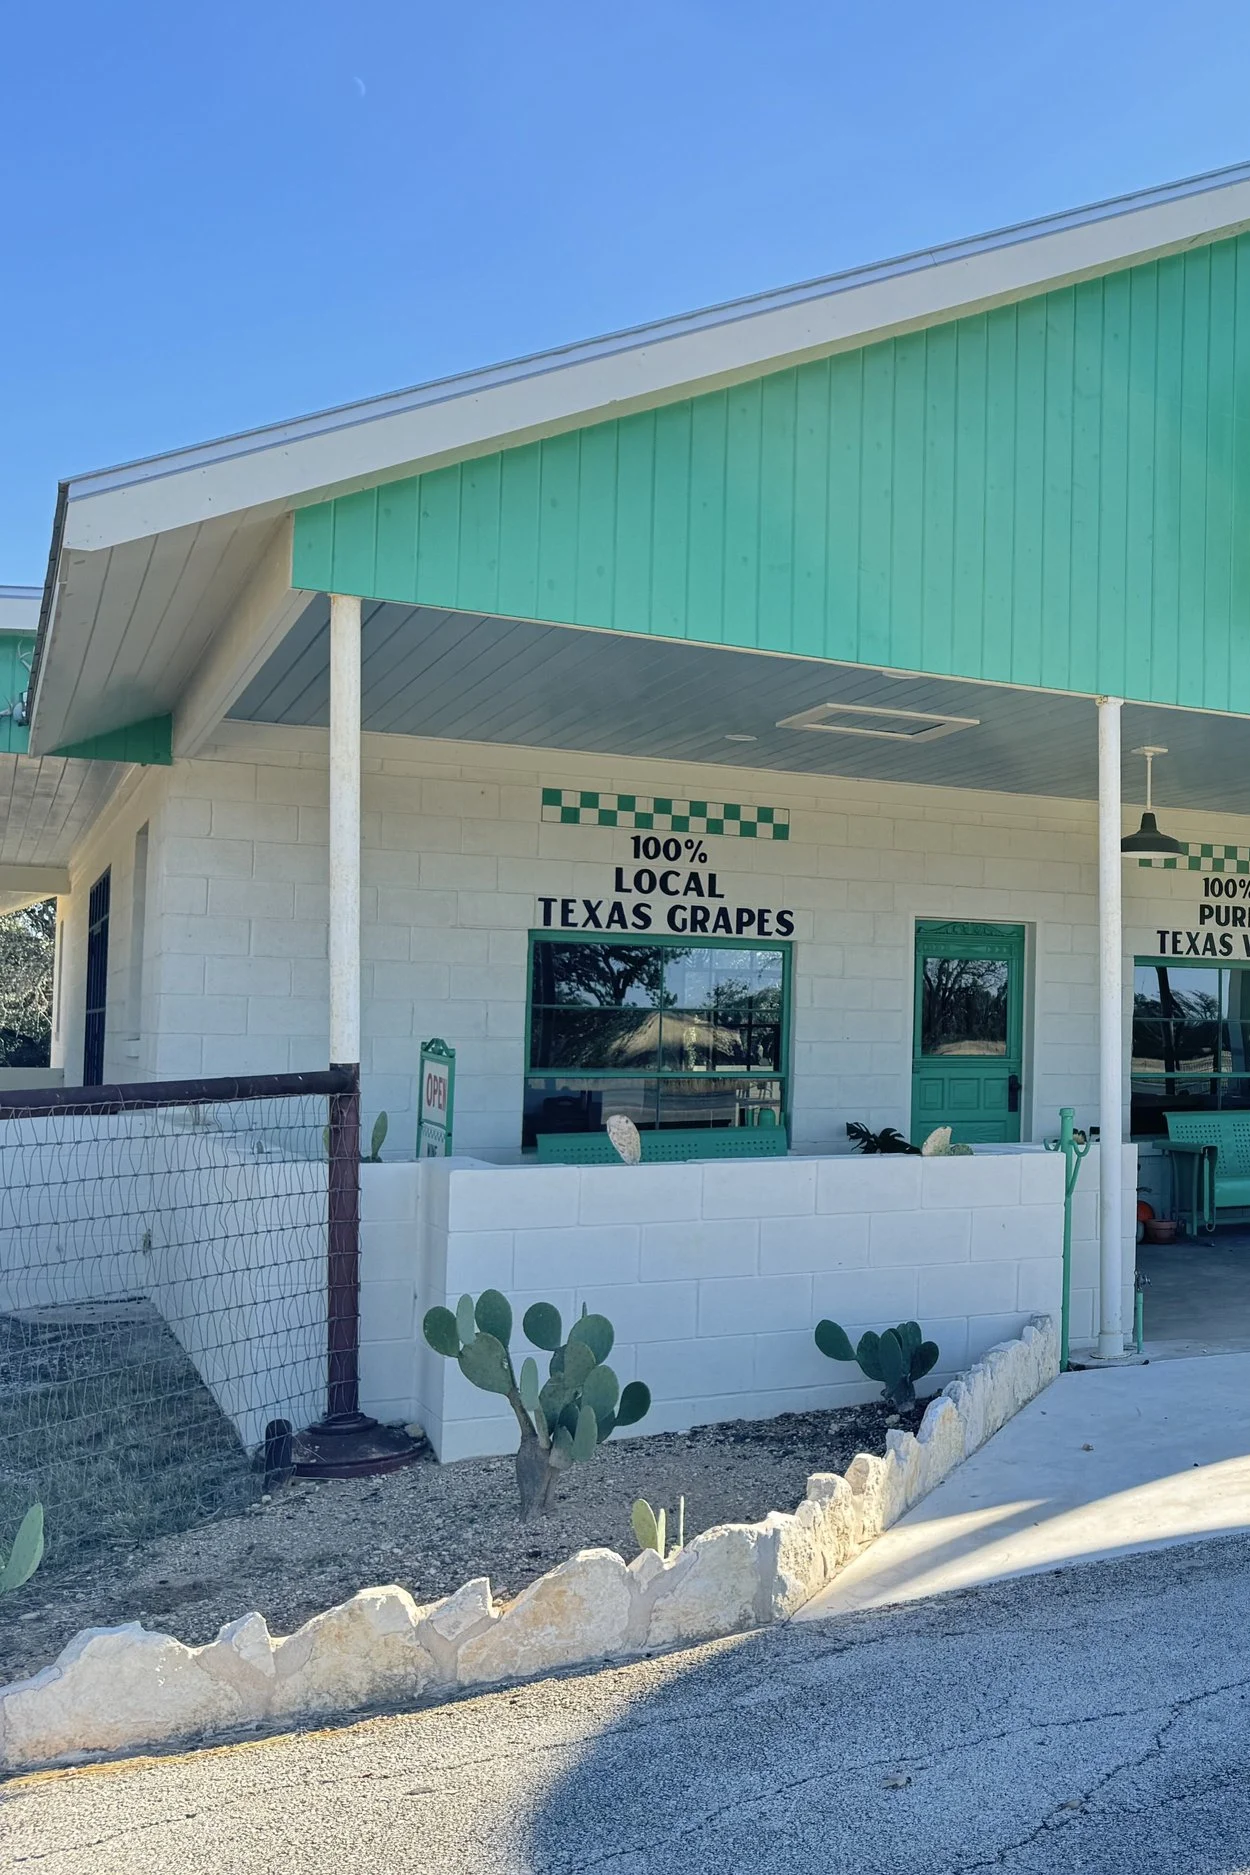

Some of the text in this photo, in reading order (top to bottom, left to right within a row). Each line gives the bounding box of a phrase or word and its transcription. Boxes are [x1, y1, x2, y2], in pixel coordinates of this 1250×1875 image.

[631, 835, 708, 864] 100%
[614, 867, 725, 899] LOCAL
[537, 897, 795, 937] TEXAS GRAPES
[1156, 930, 1233, 957] TEXAS
